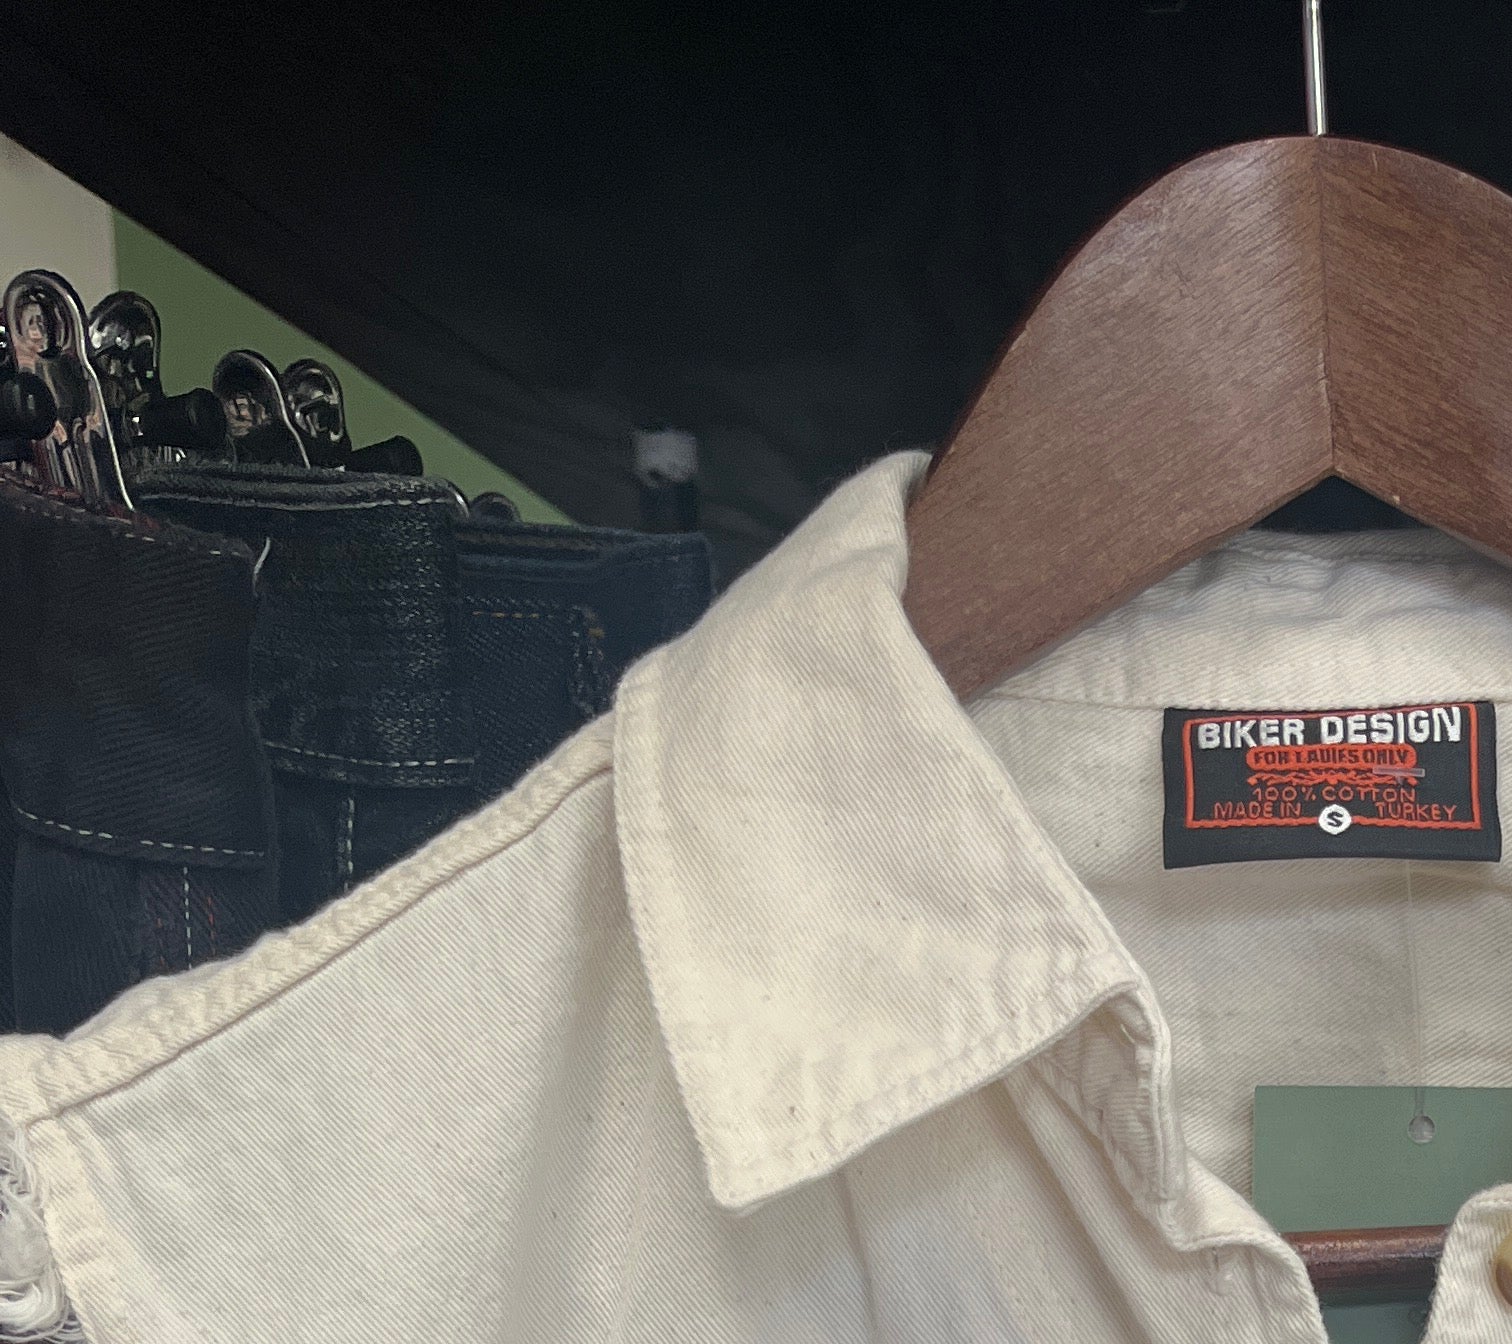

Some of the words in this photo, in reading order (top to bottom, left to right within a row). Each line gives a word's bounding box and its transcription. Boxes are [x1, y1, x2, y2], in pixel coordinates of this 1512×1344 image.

[1197, 718, 1305, 749] BIKER
[1319, 706, 1462, 744] DESIGN
[1253, 751, 1290, 765] FOR
[1294, 749, 1363, 764] LADIES
[1364, 749, 1409, 765] ONLY
[1251, 787, 1316, 803] 100%
[1320, 787, 1417, 803] COTTON
[1213, 802, 1273, 819] MADE
[1279, 802, 1302, 817] IN
[1375, 801, 1457, 821] TURKEY
[1325, 811, 1345, 828] S
